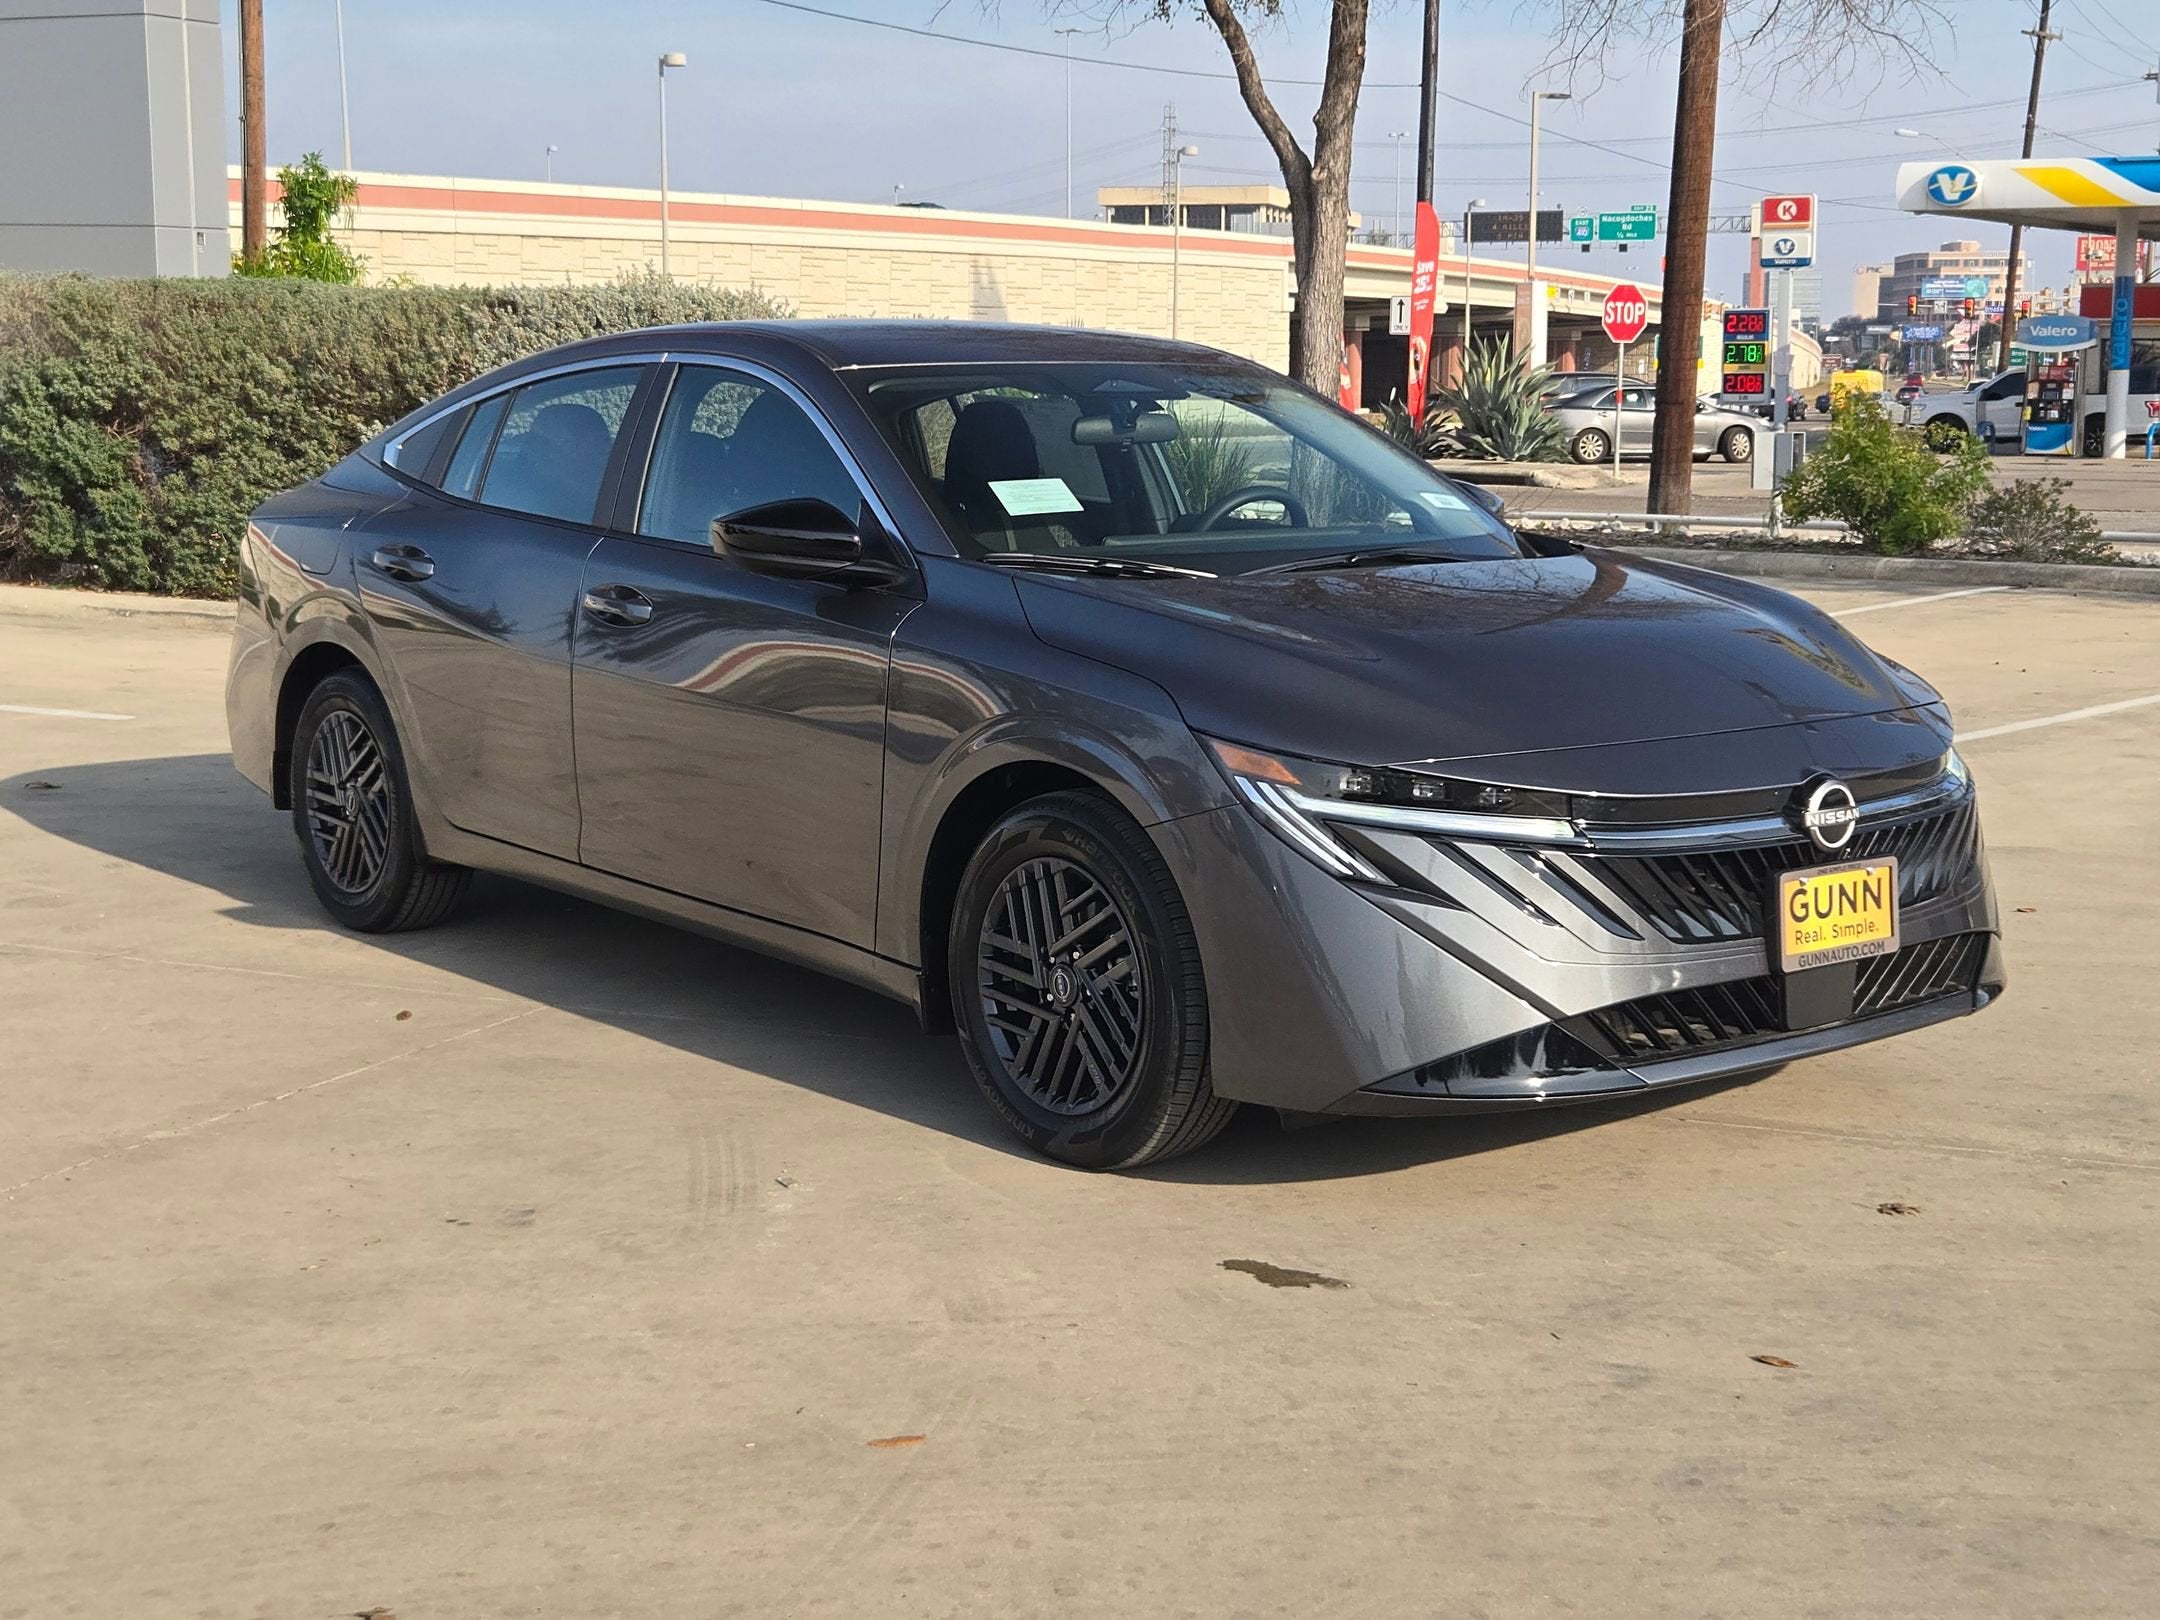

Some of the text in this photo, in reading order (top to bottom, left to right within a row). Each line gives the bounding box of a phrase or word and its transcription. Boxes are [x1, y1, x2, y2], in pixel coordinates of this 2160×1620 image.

[1602, 215, 1653, 223] Nacogdoches
[1416, 261, 1435, 274] Save
[1866, 266, 1883, 274] PNC
[1605, 301, 1645, 324] STOP
[2030, 325, 2078, 337] Valero
[1805, 807, 1860, 827] NISSAN
[1789, 877, 1882, 923] GUNN
[1795, 925, 1827, 945] Real.
[1798, 940, 1886, 968] GUNNAUTO.COM
